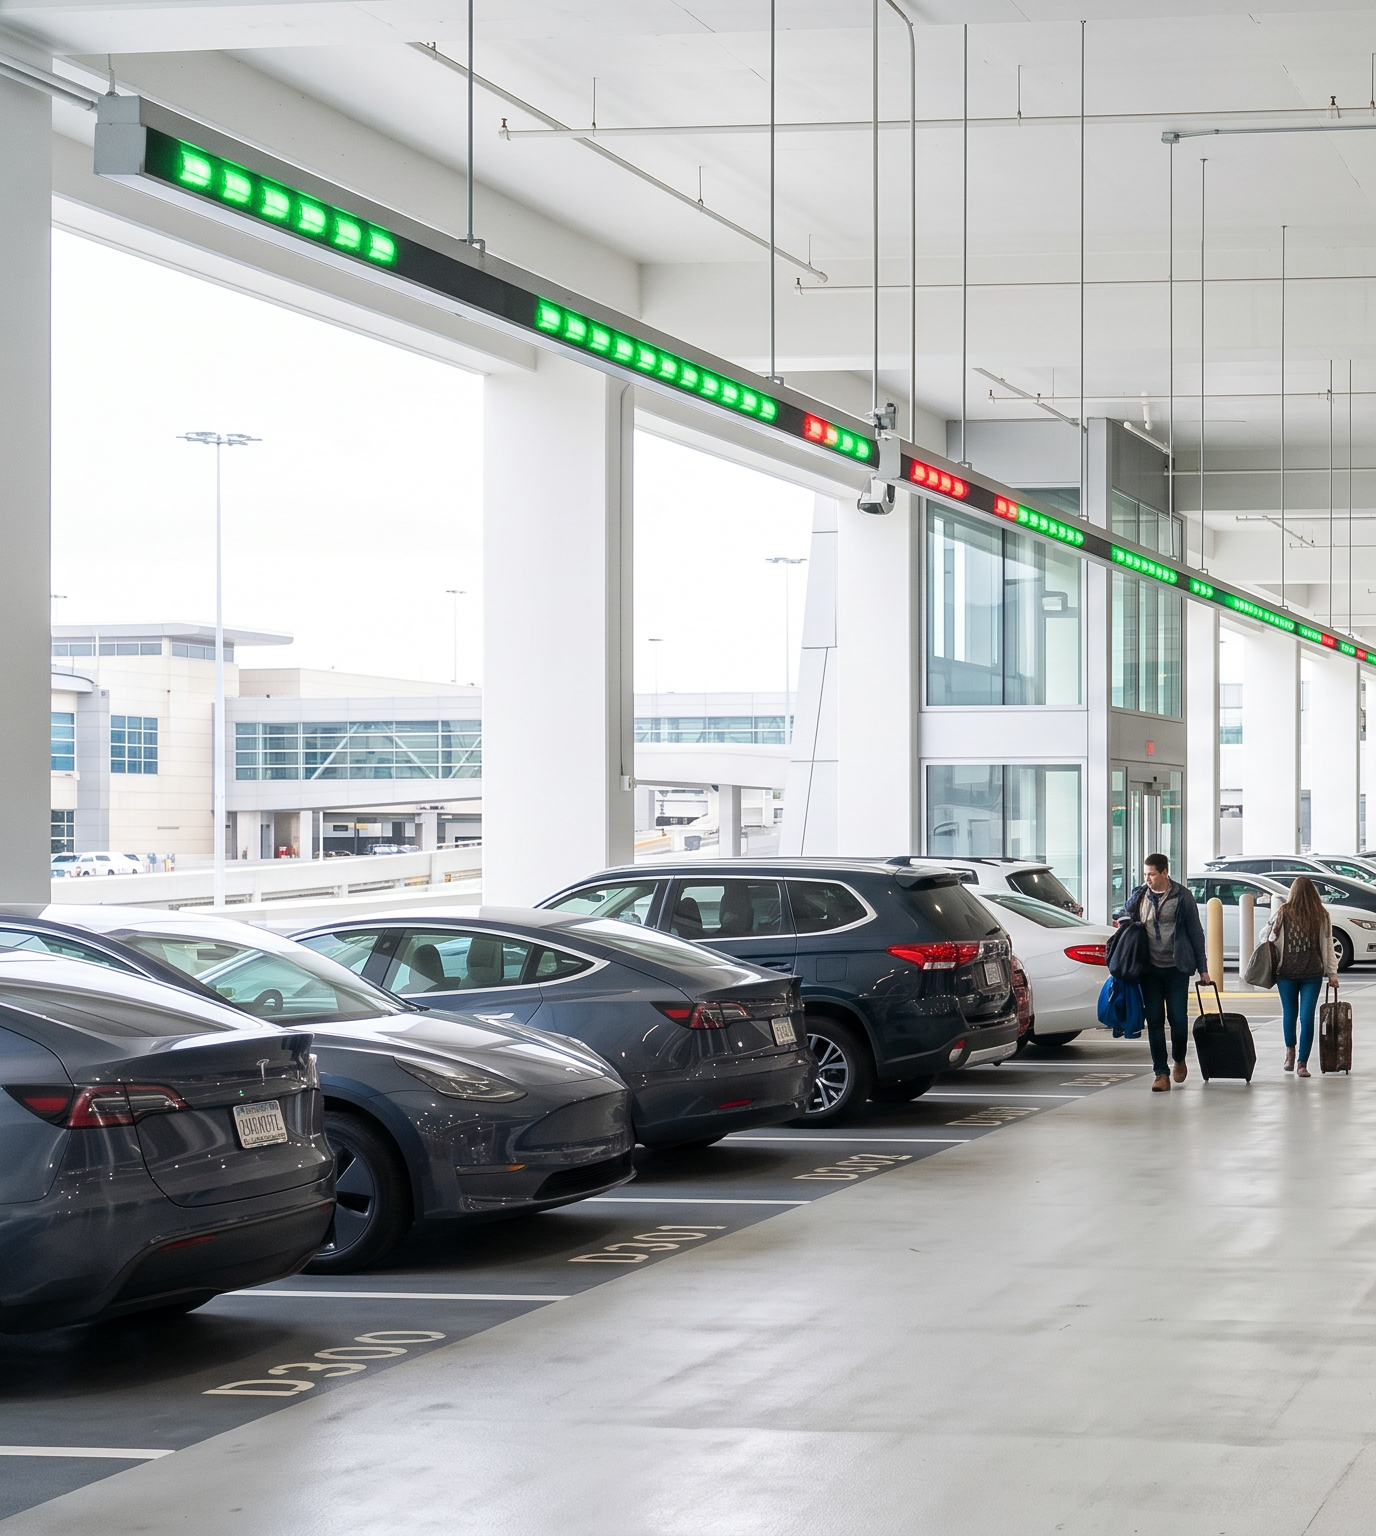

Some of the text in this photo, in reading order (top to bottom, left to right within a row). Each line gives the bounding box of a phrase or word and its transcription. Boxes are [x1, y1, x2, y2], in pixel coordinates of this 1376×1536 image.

[792, 1153, 913, 1180] D302
[568, 1223, 728, 1265] D301
[201, 1330, 447, 1397] D300
